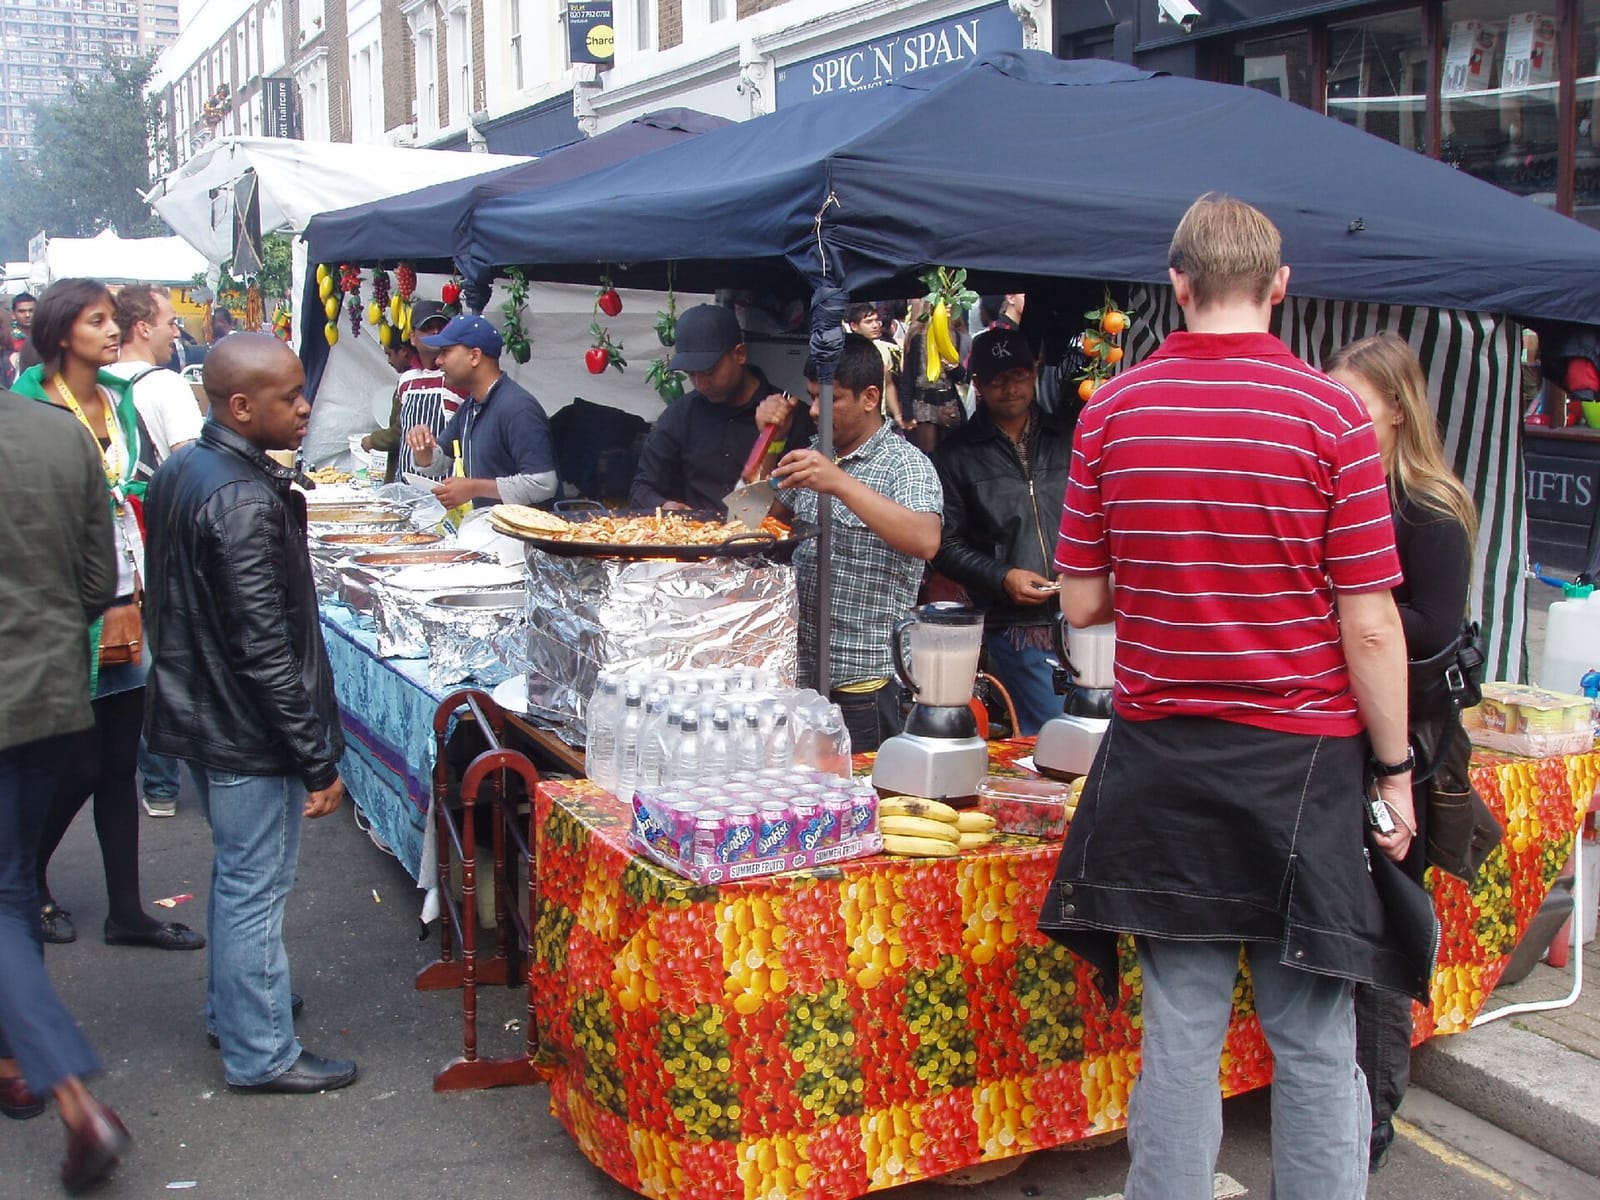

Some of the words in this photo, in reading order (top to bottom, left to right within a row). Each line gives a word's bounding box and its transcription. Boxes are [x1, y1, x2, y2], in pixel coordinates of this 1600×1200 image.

[586, 36, 614, 45] Chard
[812, 51, 864, 95] SPIC
[904, 19, 980, 73] SPAN
[278, 82, 287, 121] haircare
[280, 123, 288, 138] ott
[1527, 470, 1592, 506] IFTS
[815, 846, 842, 862] SUMMER
[731, 862, 760, 877] SUMMER
[760, 859, 784, 873] FRUITS
